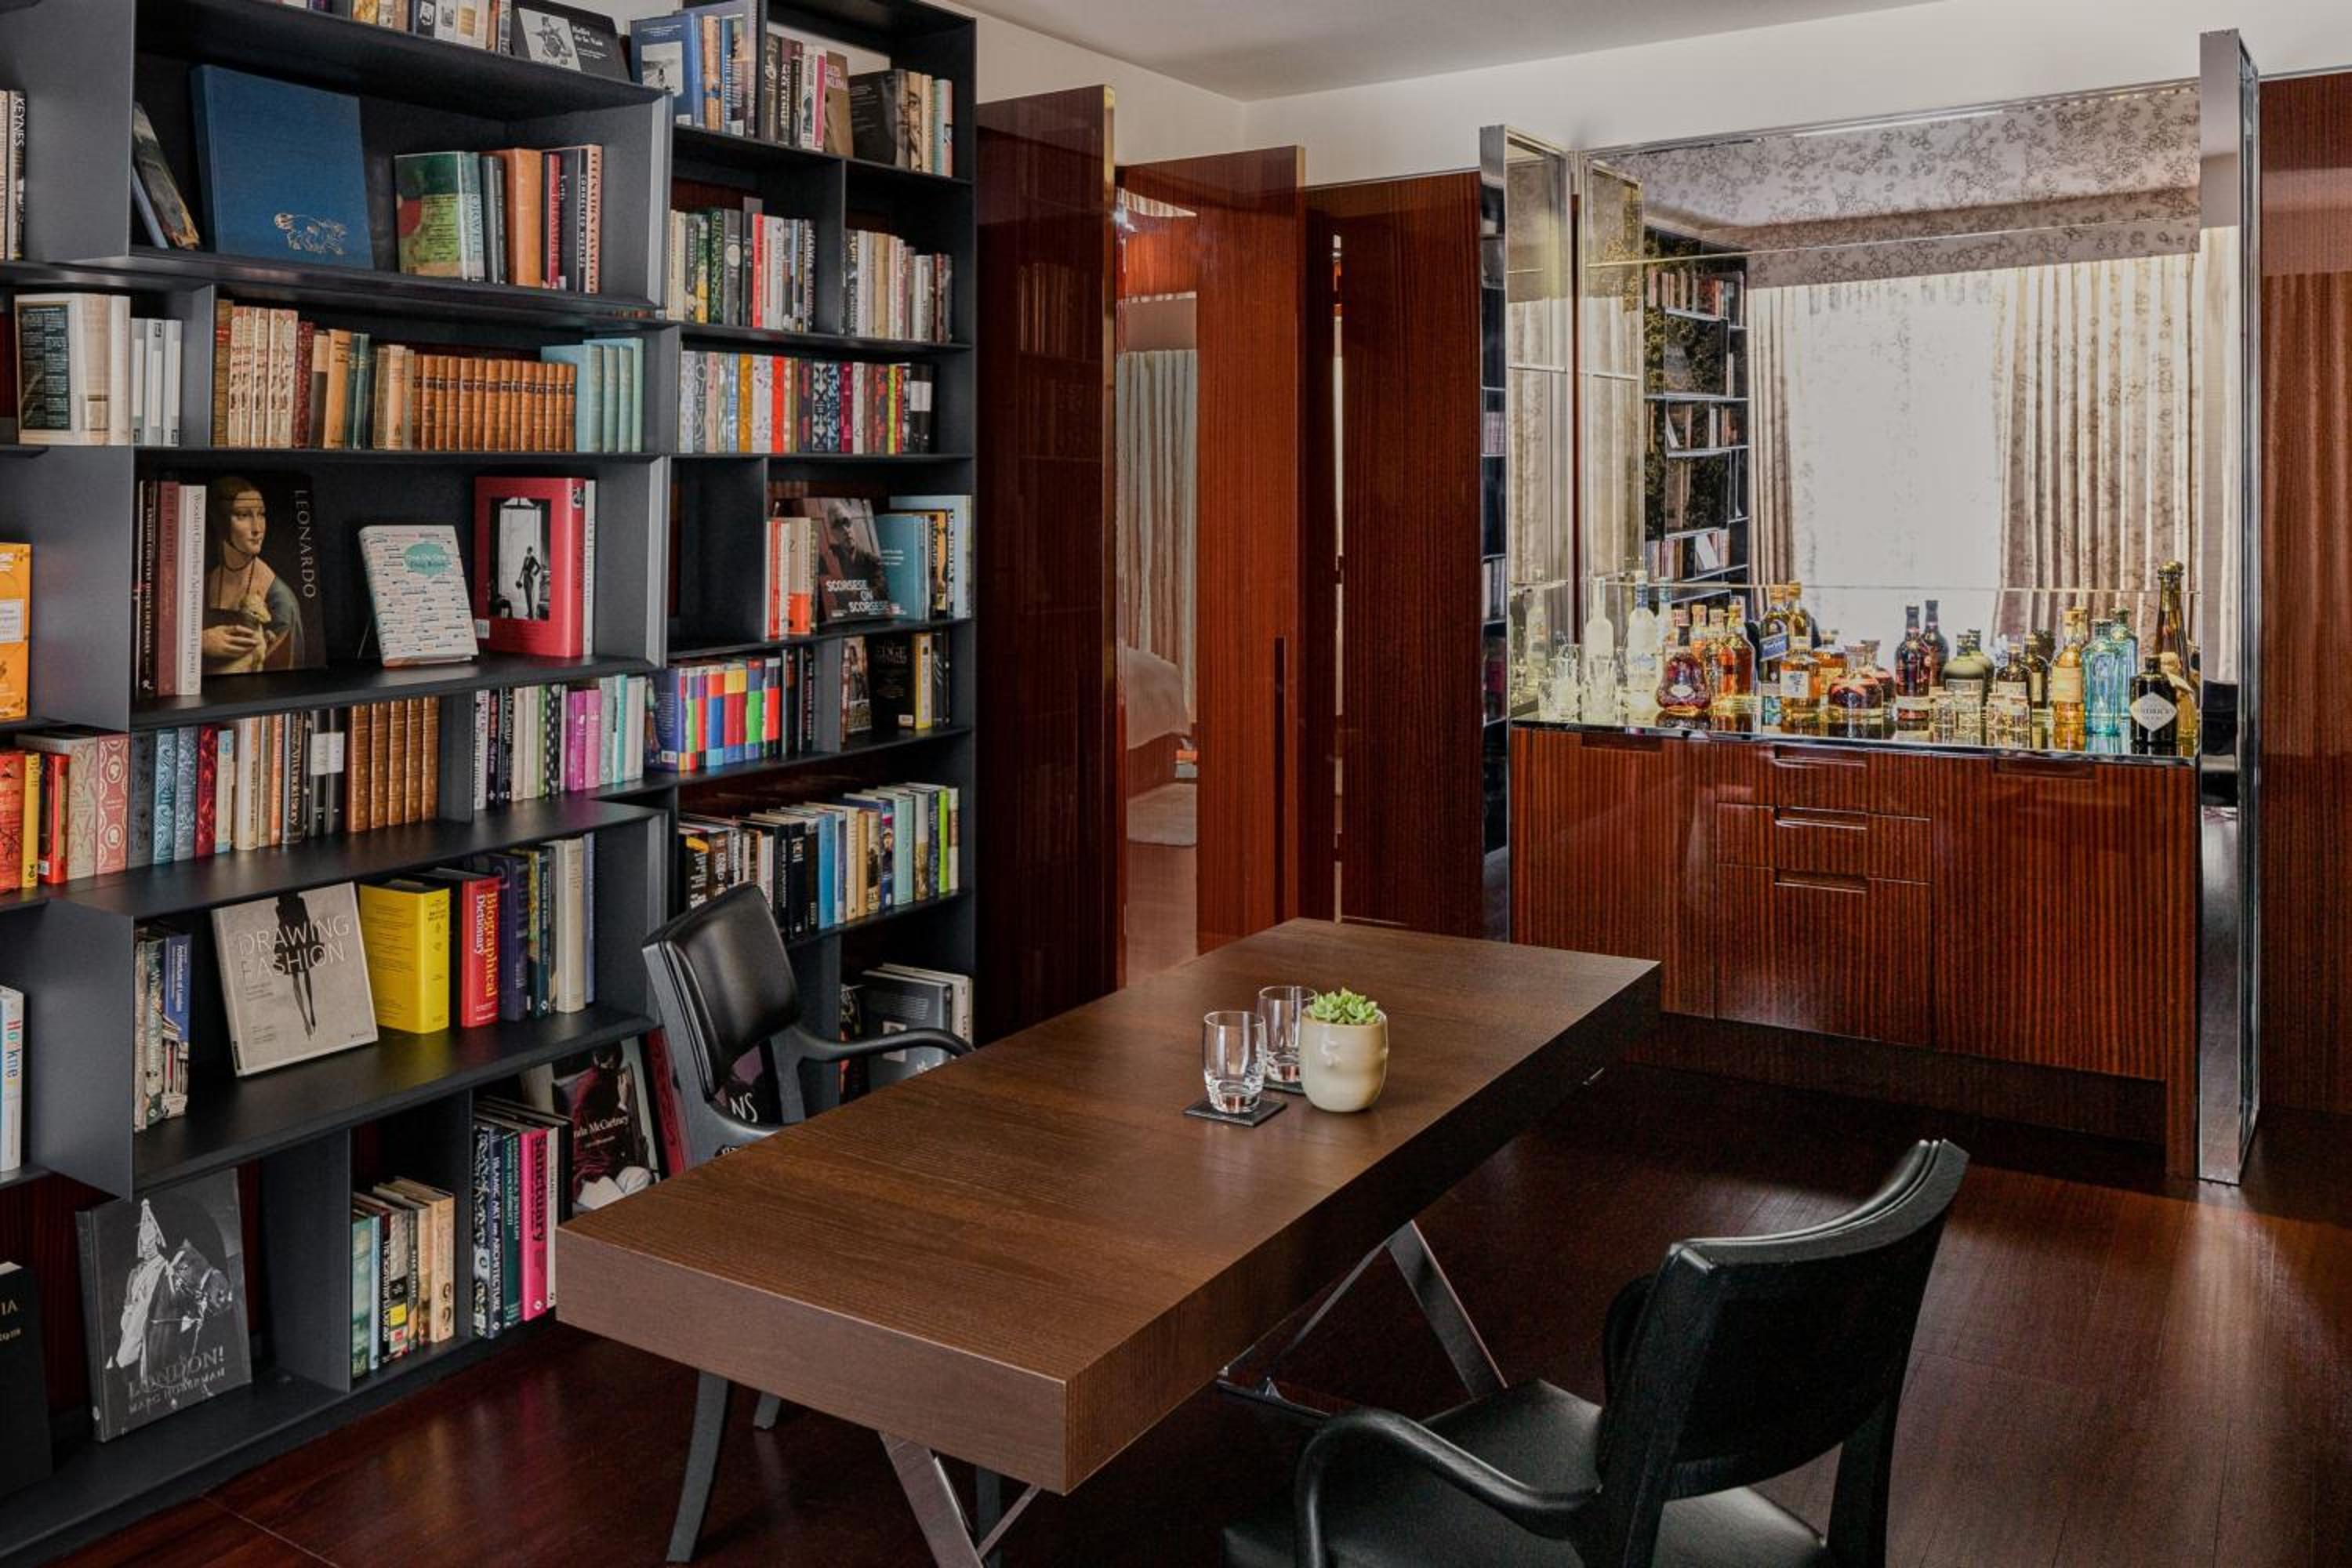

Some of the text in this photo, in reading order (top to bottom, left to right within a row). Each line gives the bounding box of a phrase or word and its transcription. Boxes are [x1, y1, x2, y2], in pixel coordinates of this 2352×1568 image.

[13, 97, 25, 147] KEYNES
[470, 194, 483, 254] ORWELL
[192, 493, 201, 531] Wooden
[294, 489, 315, 599] LEONARDO
[826, 579, 867, 592] SCORSESE
[860, 590, 873, 601] ON
[848, 601, 889, 612] SCORSESE
[238, 916, 350, 956] DRAWING
[474, 894, 485, 956] Dictionary
[482, 891, 499, 999] Biographical
[240, 942, 345, 982] FASHION
[589, 1115, 629, 1134] McCartney
[492, 1156, 501, 1198] ISLAMIC
[534, 1134, 546, 1242] Sanctuary
[492, 1200, 500, 1220] ART
[492, 1237, 501, 1312] ARCHITECTURE
